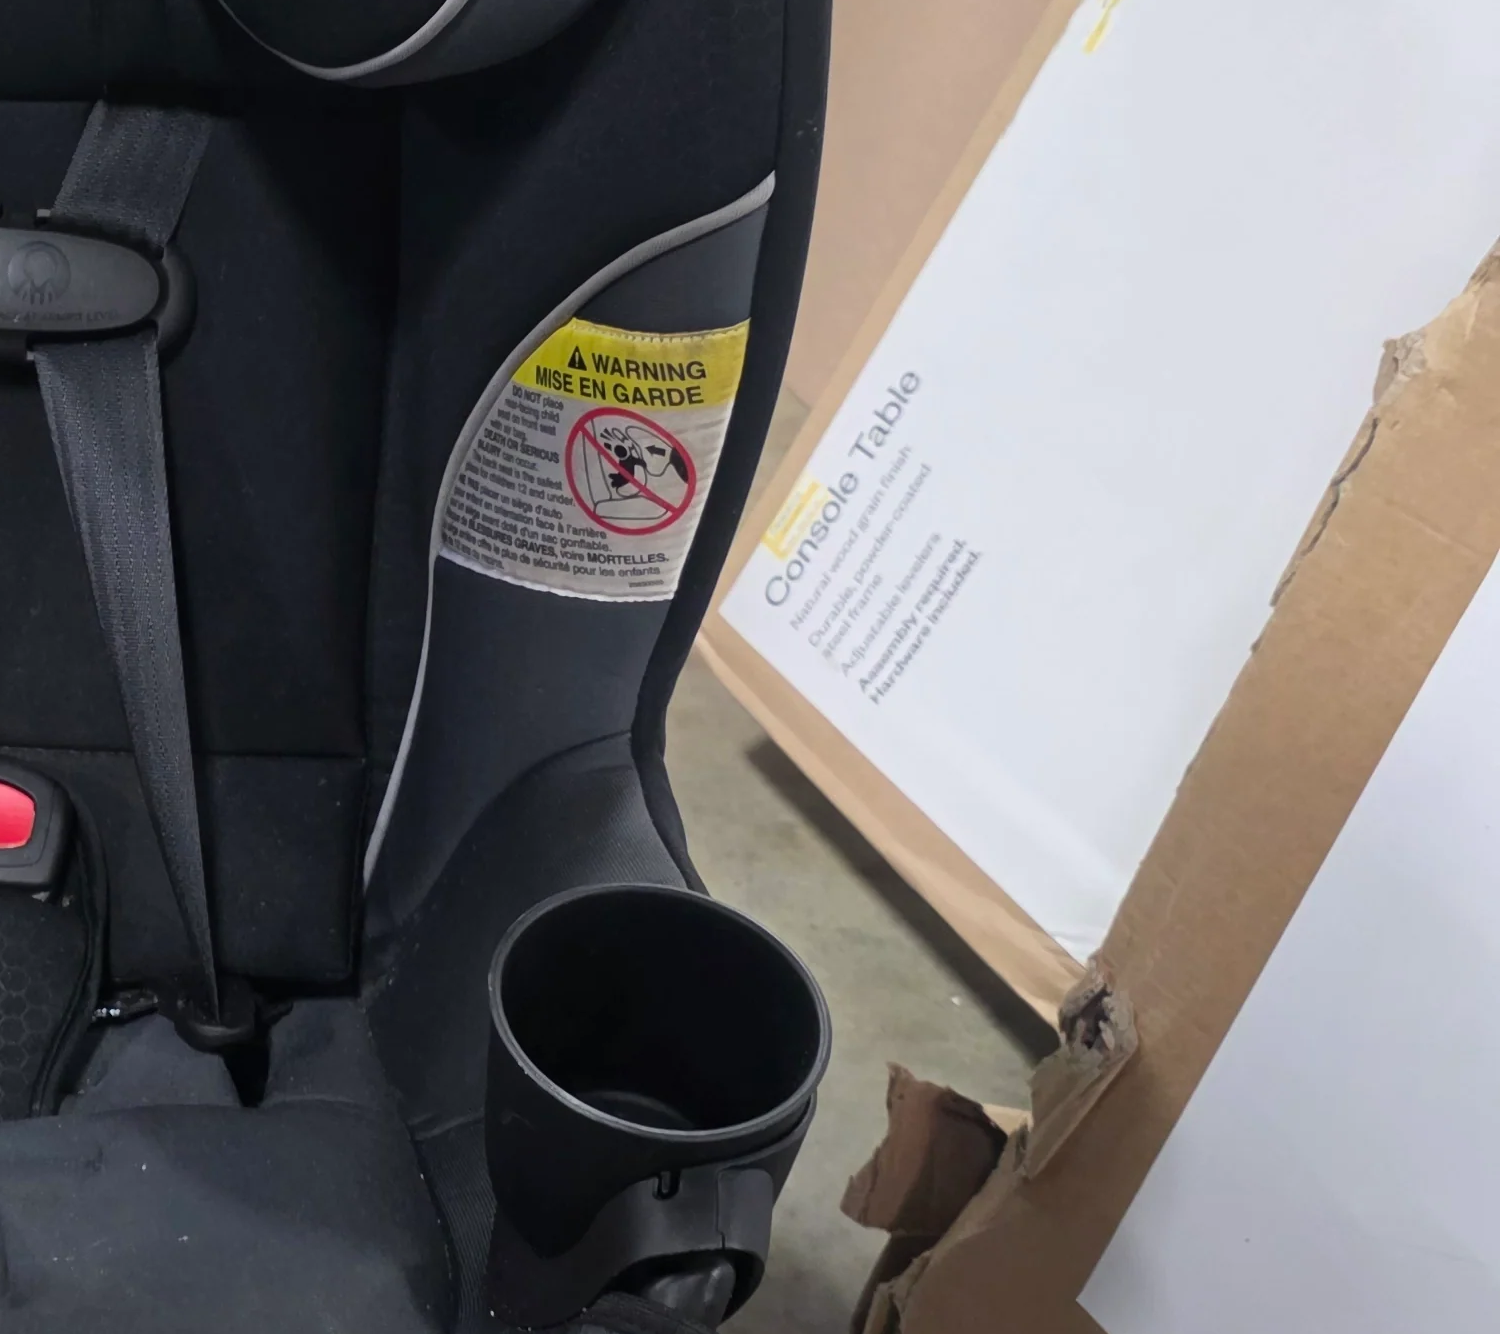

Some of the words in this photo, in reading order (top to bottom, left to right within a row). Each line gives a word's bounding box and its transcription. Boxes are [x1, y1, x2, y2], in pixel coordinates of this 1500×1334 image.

[591, 352, 707, 381] WARNING
[512, 385, 523, 398] DO
[524, 390, 541, 404] NOT
[535, 365, 574, 394] MISE
[579, 376, 607, 401] EN
[612, 383, 705, 407] GARDE
[520, 444, 560, 464] SERIOUS
[765, 471, 859, 608] Console
[848, 370, 921, 460] Table
[587, 552, 670, 565] MORTELLES.
[572, 565, 596, 576] pour
